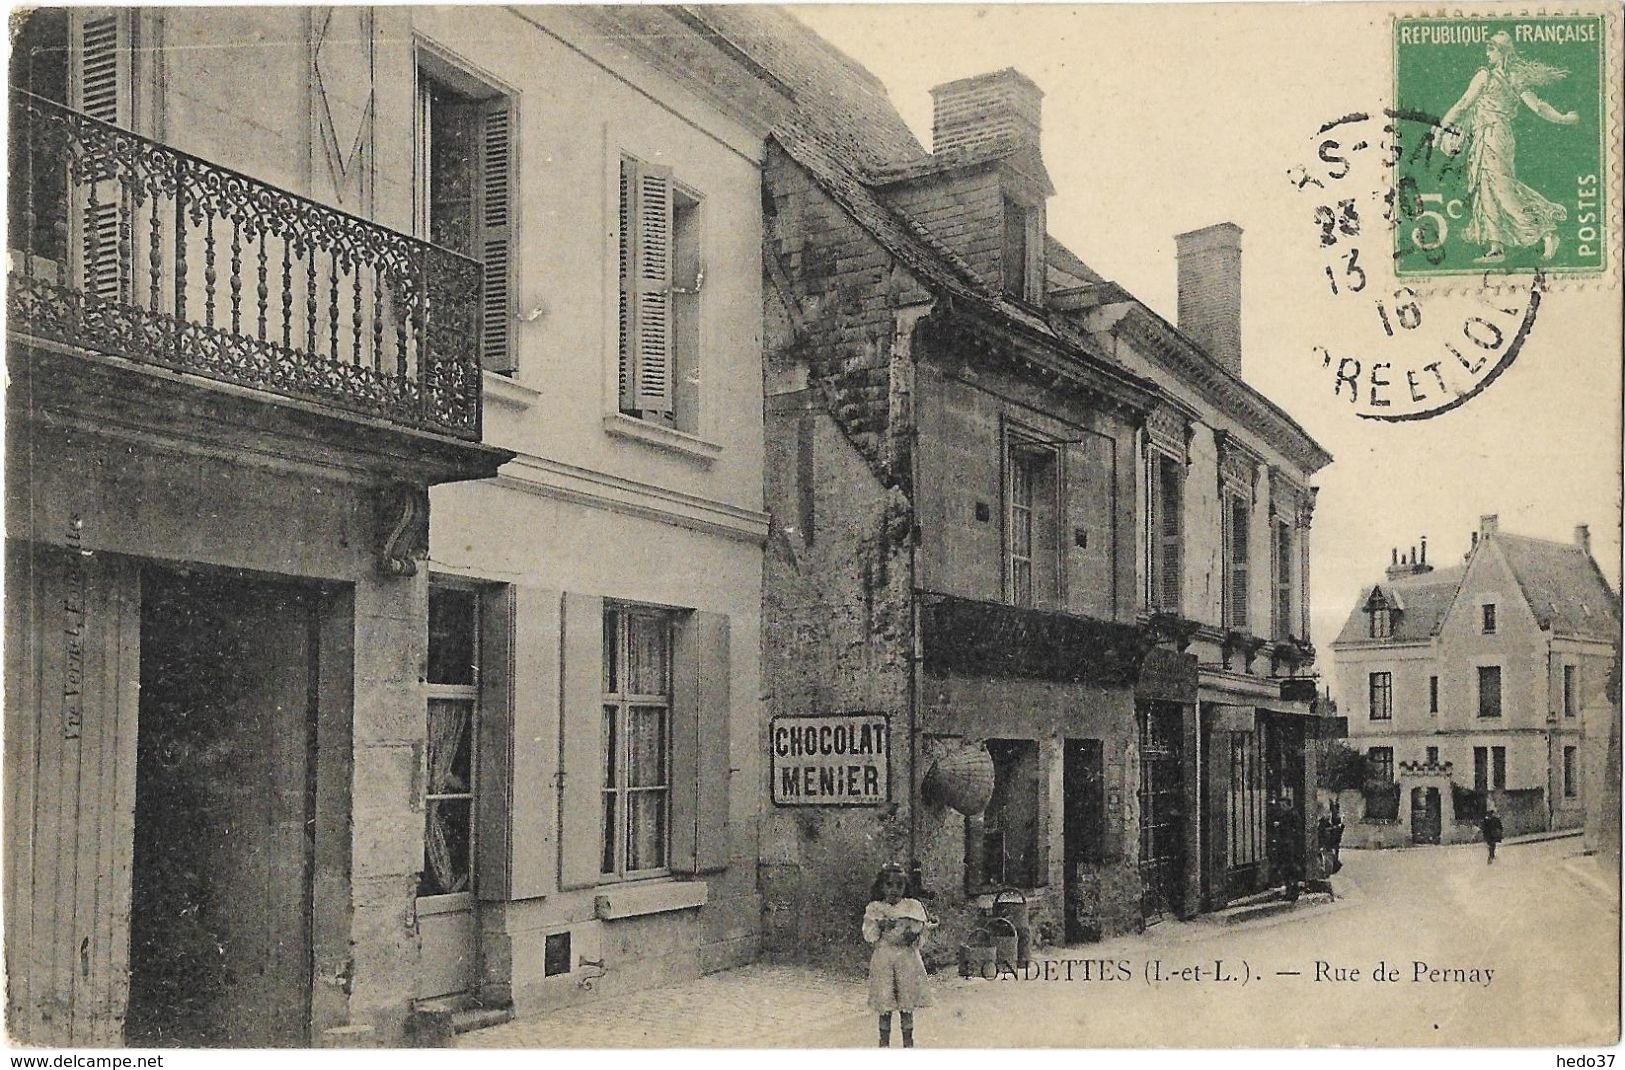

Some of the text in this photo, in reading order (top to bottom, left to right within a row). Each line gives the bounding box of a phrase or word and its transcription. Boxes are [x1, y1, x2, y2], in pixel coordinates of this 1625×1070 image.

[1515, 24, 1596, 44] FRANÇAISE
[1578, 174, 1597, 257] POSTES
[775, 723, 884, 757] CHOCOLAT
[782, 765, 879, 796] MENIER
[1314, 960, 1360, 983] Rue
[1373, 960, 1400, 982] de
[1411, 960, 1495, 988] Pernay
